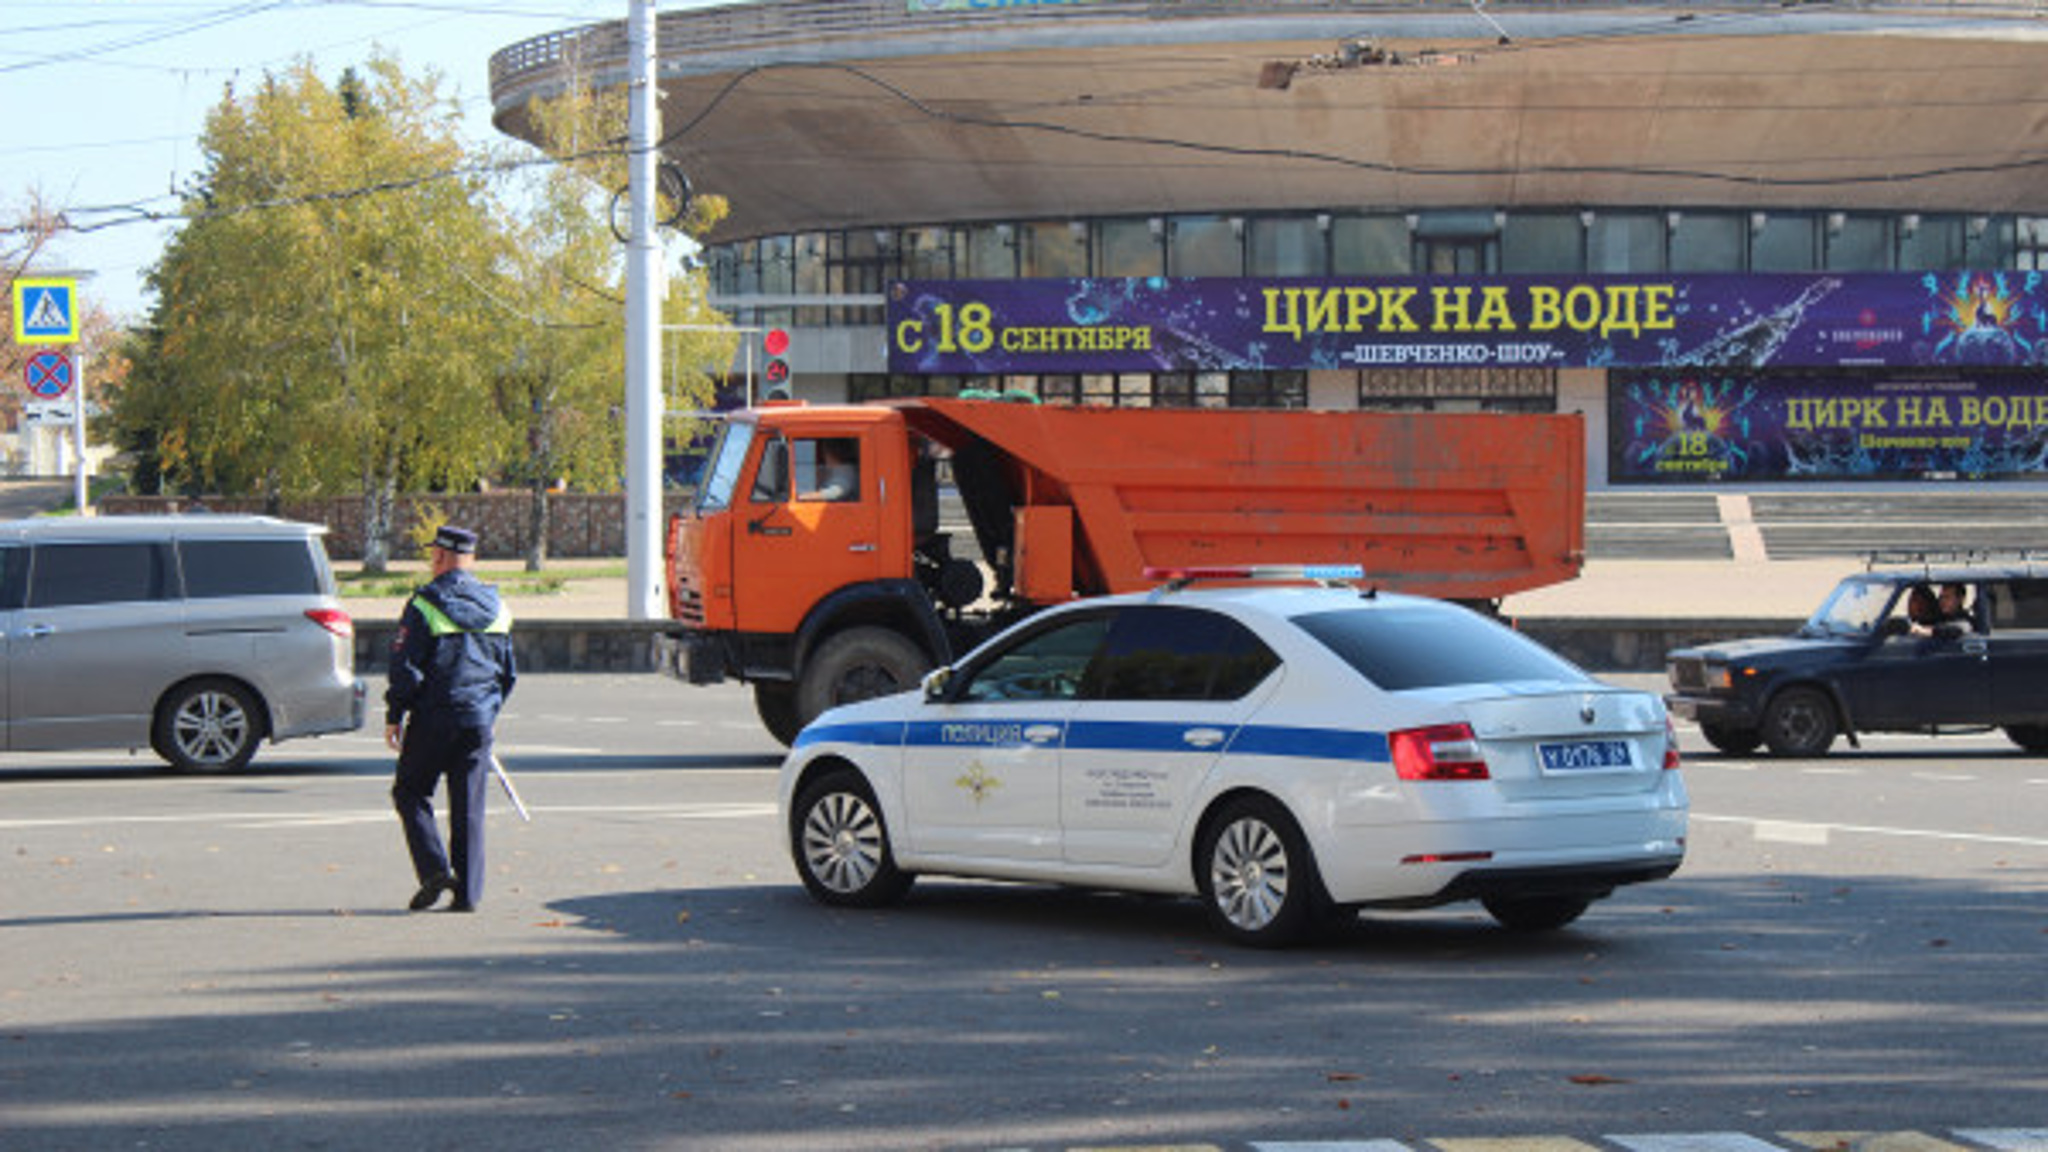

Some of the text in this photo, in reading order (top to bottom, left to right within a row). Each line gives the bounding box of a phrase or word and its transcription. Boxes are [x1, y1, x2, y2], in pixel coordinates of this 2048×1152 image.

[897, 303, 1152, 353] С 18 СЕНТЯБРЯ
[1262, 285, 1675, 342] ЦИРК НА ВОДЕ
[1785, 397, 1889, 431] ЦИРК
[1897, 396, 1952, 427] НА
[1678, 431, 1708, 456] 18
[941, 724, 1022, 743] ПОЛИЦИЯ
